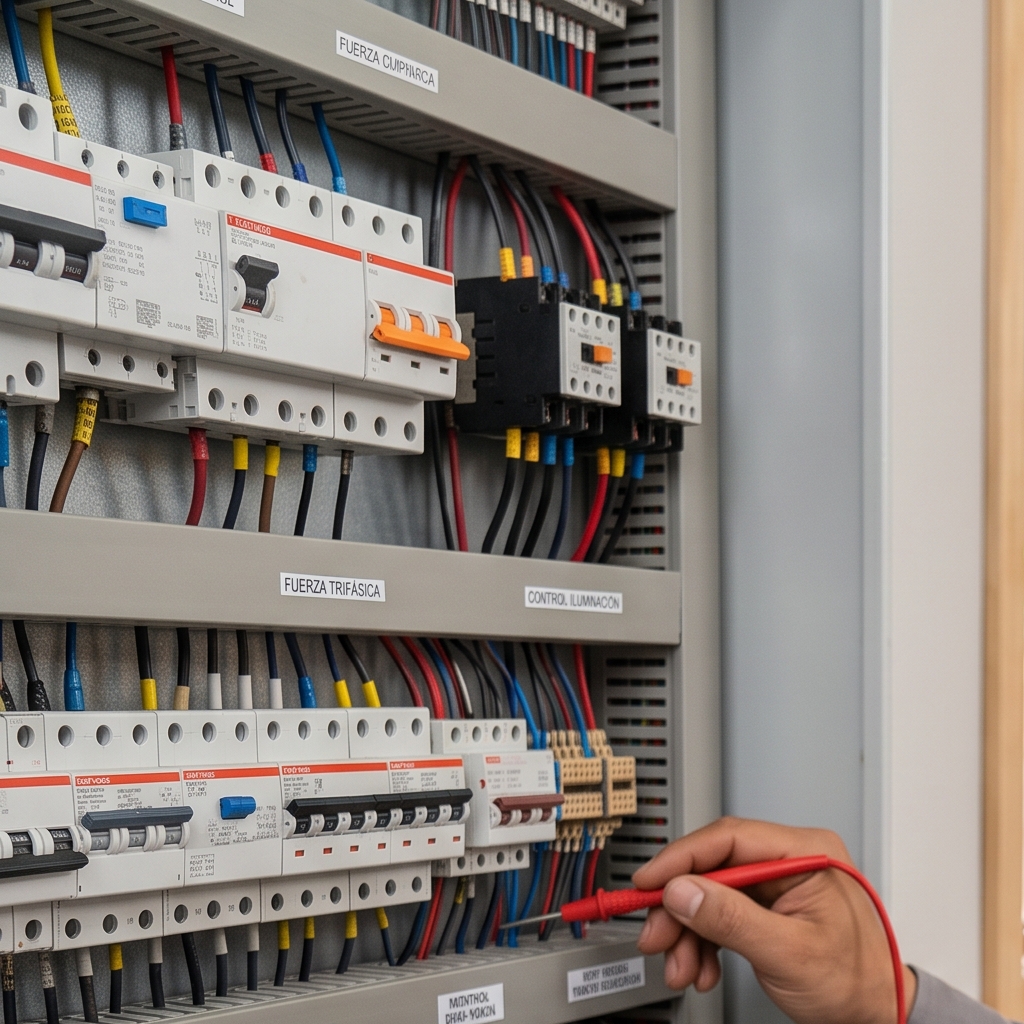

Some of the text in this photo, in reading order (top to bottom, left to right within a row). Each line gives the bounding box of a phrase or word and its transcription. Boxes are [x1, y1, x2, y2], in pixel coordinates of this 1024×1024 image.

[340, 36, 380, 65] FUERZA
[284, 577, 380, 598] FUERZA TRIFÁSICA
